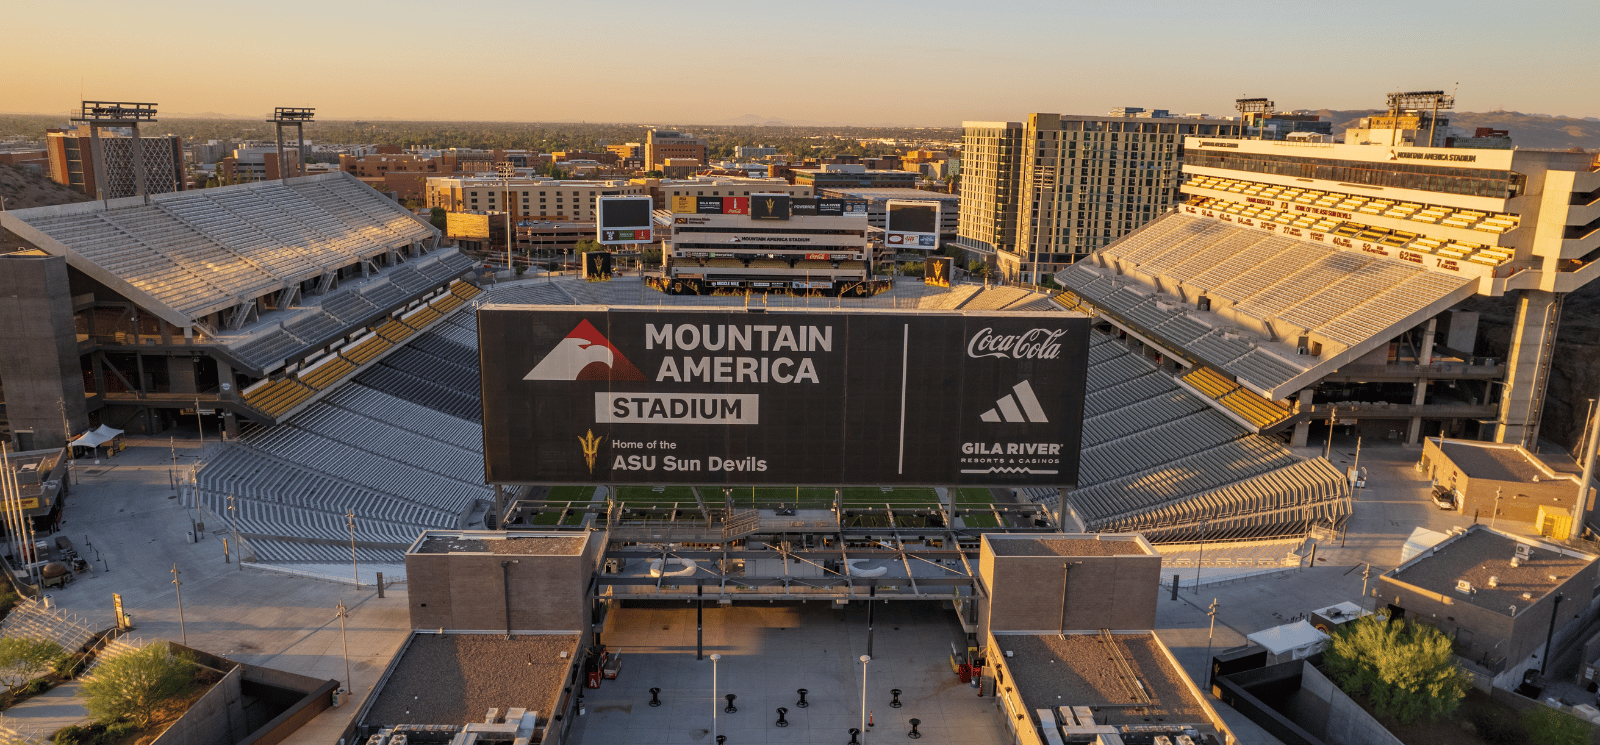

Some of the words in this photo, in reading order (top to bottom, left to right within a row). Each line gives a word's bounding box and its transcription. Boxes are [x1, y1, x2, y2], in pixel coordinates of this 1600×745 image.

[1397, 152, 1423, 160] MOUNTAIN
[1424, 153, 1448, 161] AMERICA
[1449, 154, 1476, 162] STADIUM
[1283, 226, 1290, 234] 27
[1333, 237, 1341, 245] 40
[1363, 243, 1371, 252] 52
[1400, 251, 1409, 260] 62
[1437, 259, 1442, 267] 7
[646, 324, 833, 352] MOUNTAIN
[968, 327, 1068, 360] Coca-Cola
[656, 356, 820, 384] AMERICA
[613, 398, 742, 420] STADIUM
[613, 440, 644, 449] Home
[647, 440, 658, 449] of
[660, 440, 677, 450] the
[962, 442, 1004, 455] GILA
[1007, 443, 1061, 455] RIVER
[613, 455, 656, 471] ASU
[663, 456, 701, 472] Sun
[709, 456, 768, 472] Devils
